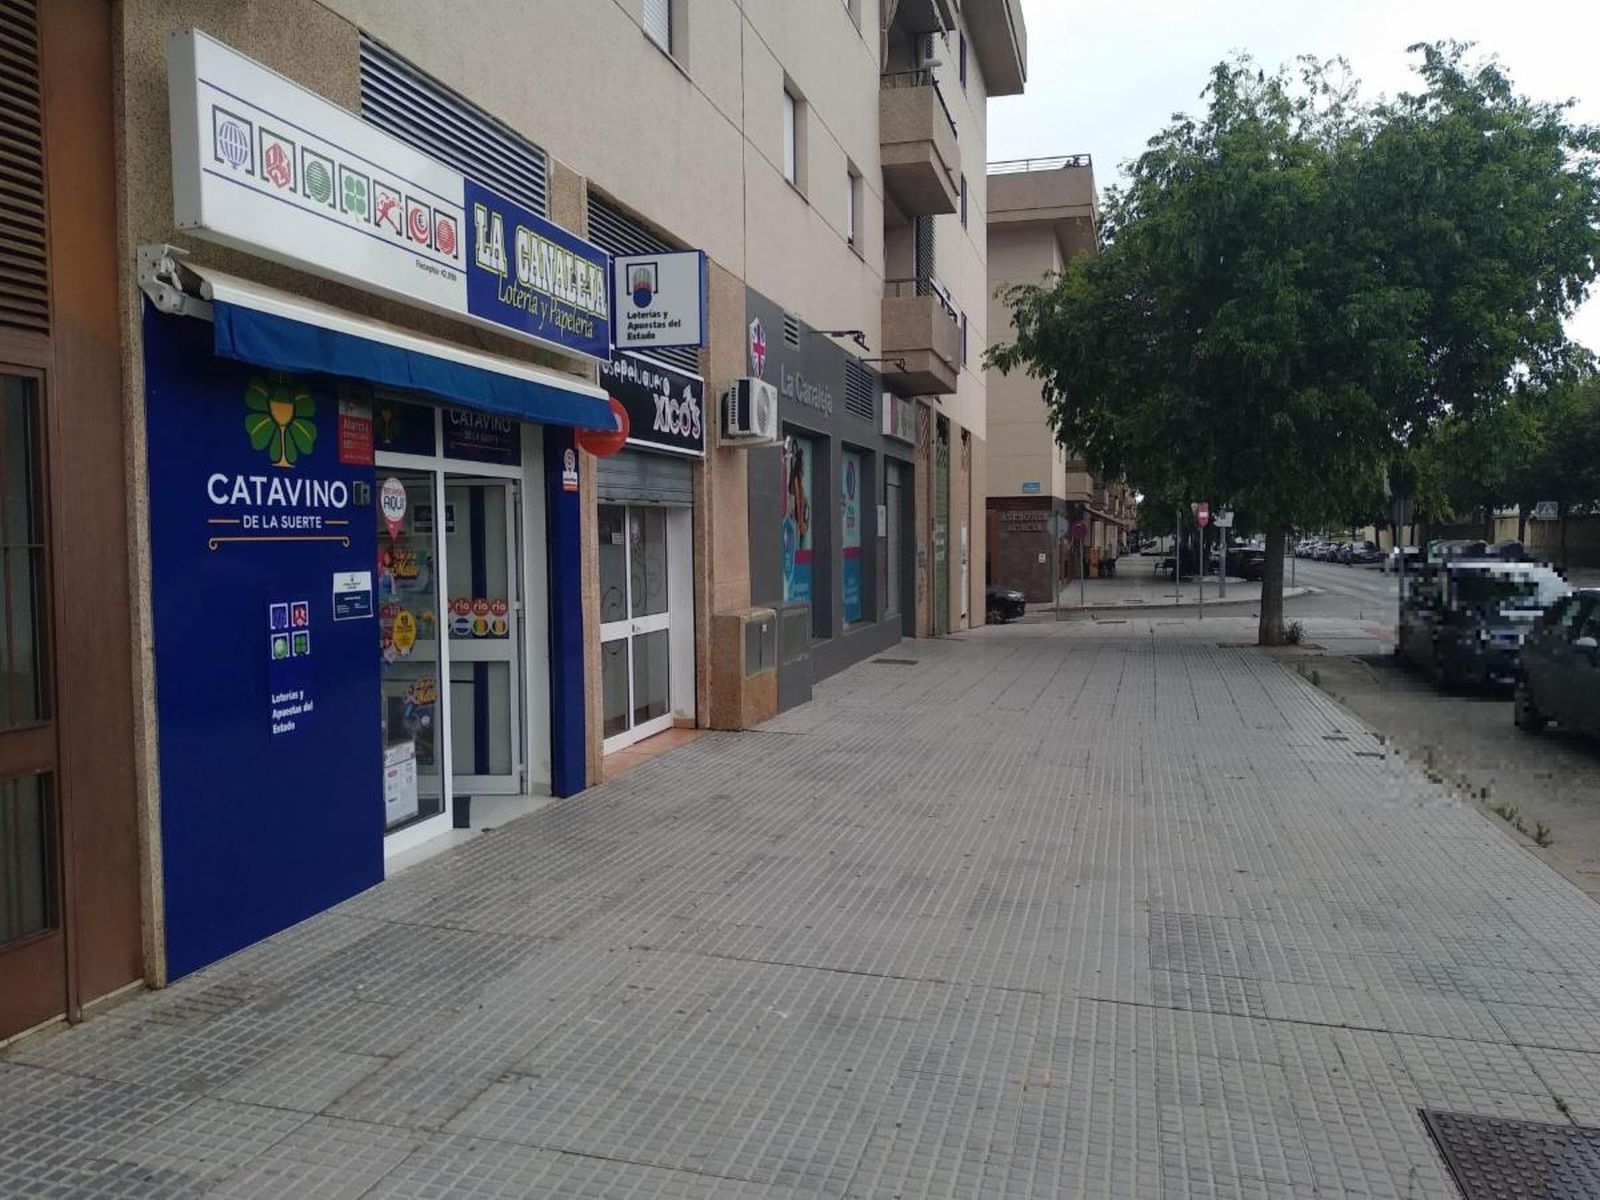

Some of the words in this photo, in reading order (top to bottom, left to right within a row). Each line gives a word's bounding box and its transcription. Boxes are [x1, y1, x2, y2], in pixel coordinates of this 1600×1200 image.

[474, 203, 507, 277] LA
[515, 225, 607, 320] CANALEJA
[540, 300, 548, 330] y
[663, 311, 669, 320] y
[627, 322, 666, 331] Apuestas
[668, 319, 681, 328] del
[627, 331, 656, 340] Estado
[207, 473, 348, 508] CATAVINO
[243, 515, 259, 529] DE
[262, 515, 279, 529] LA
[281, 515, 322, 529] SUERTE
